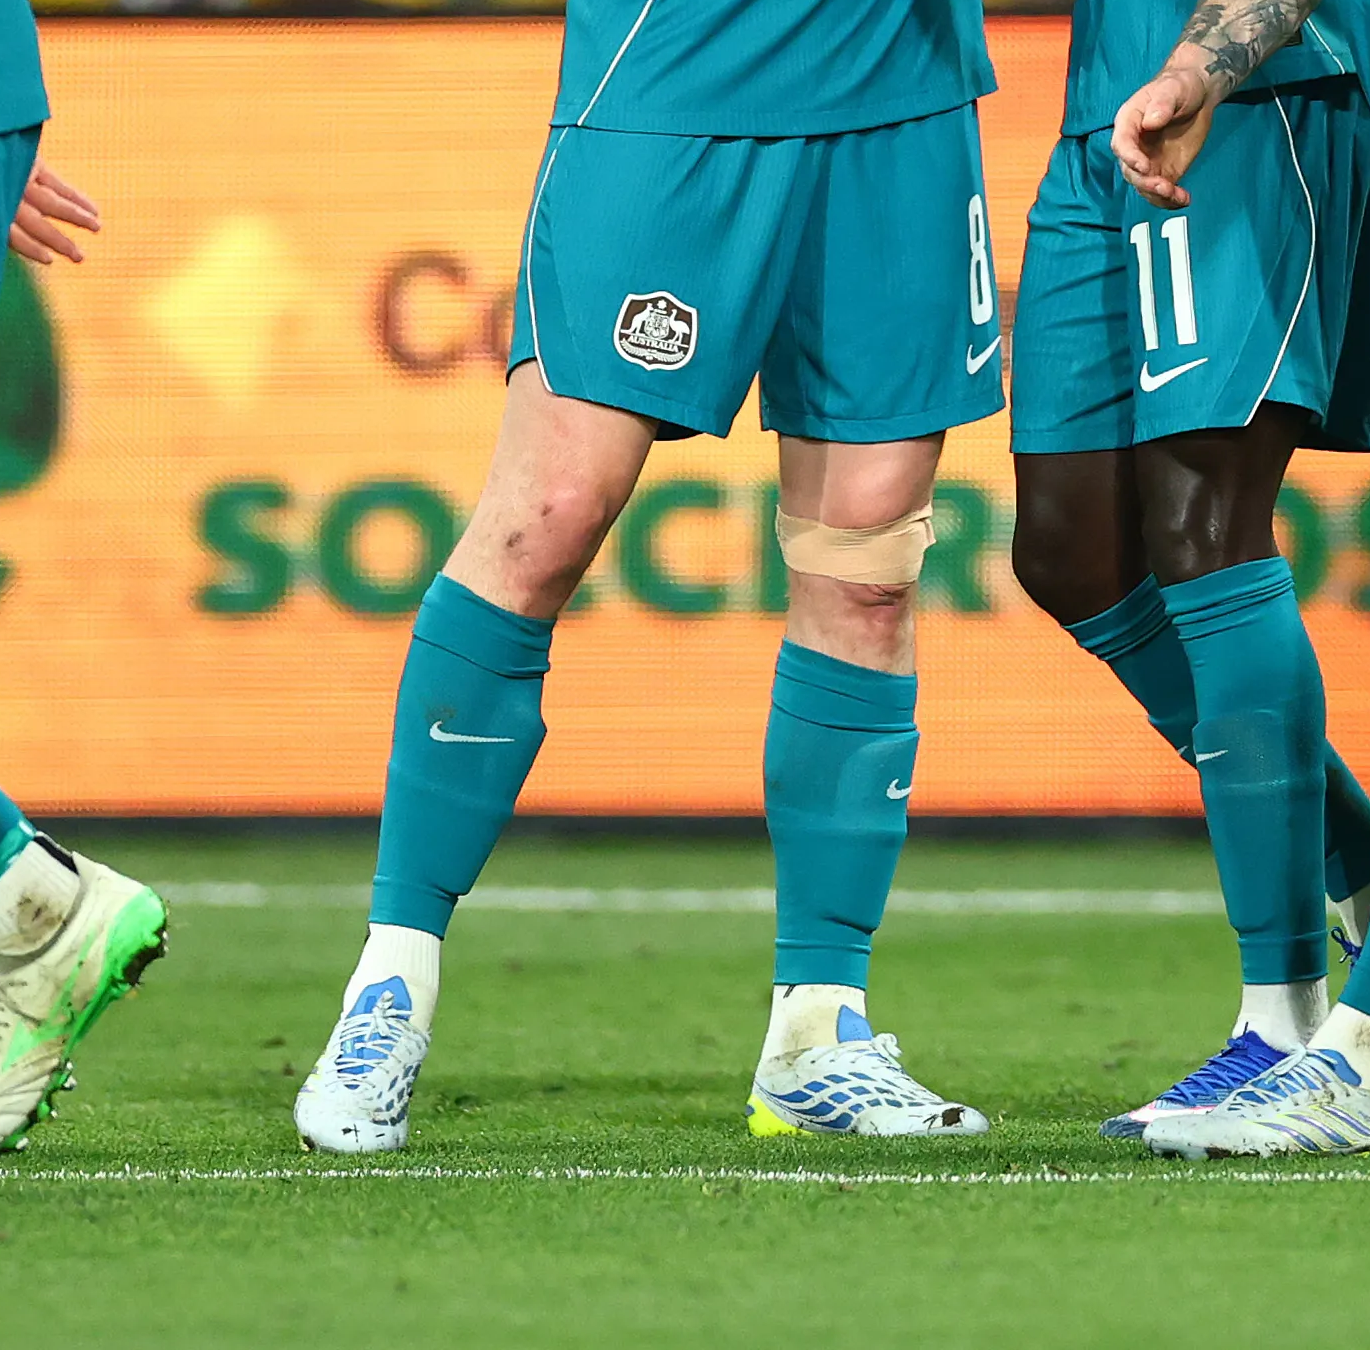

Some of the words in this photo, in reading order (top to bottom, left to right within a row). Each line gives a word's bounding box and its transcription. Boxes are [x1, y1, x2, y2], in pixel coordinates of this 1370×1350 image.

[967, 193, 993, 325] 8
[1130, 215, 1198, 351] 11
[627, 335, 679, 353] AUSTRALIA
